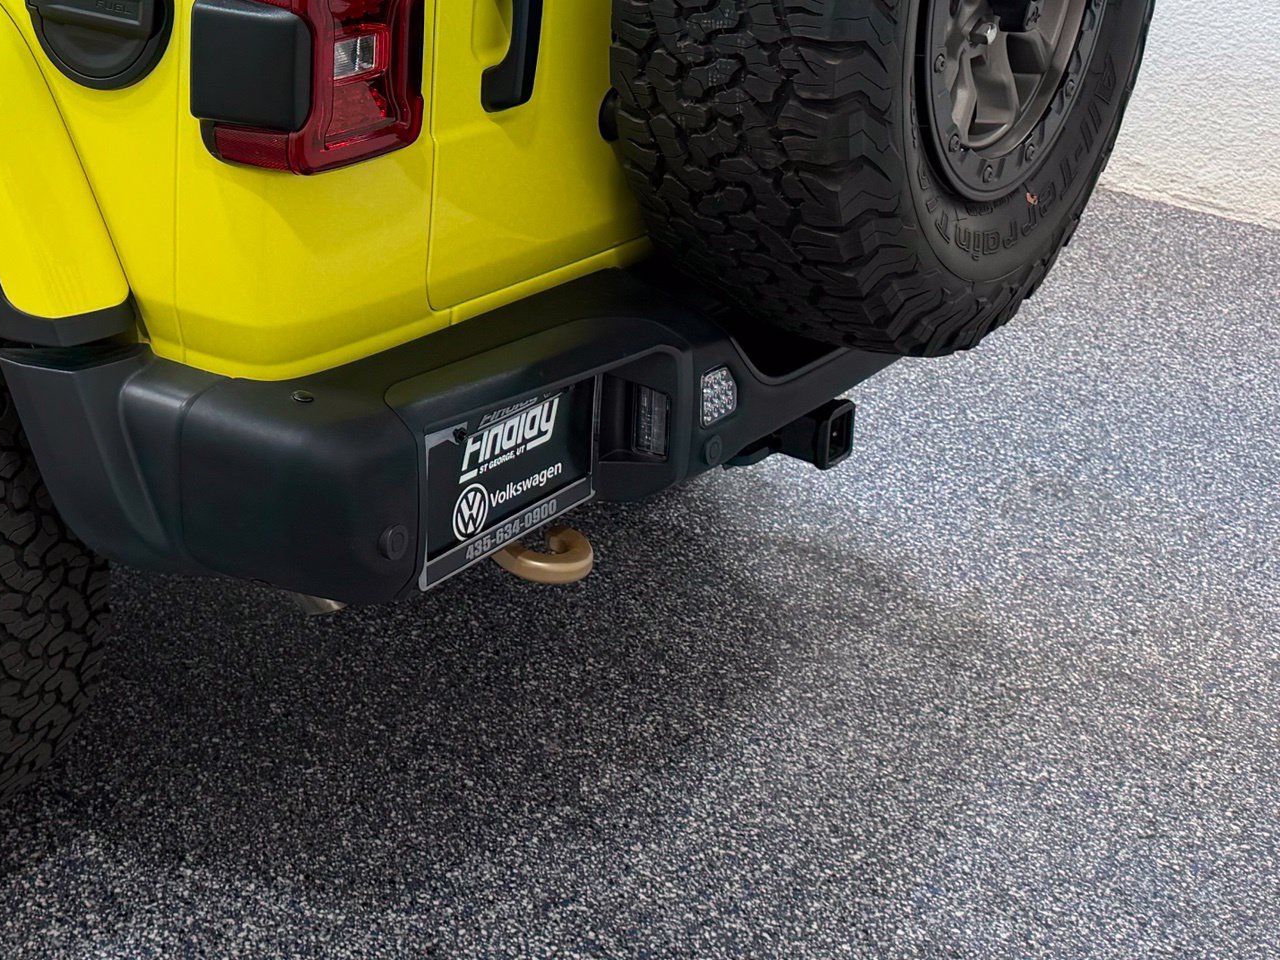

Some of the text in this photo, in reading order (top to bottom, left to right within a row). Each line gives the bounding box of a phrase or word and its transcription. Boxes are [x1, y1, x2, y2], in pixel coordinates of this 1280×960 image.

[95, 0, 132, 15] FUEL
[461, 397, 560, 472] Findlay
[479, 445, 526, 474] ST GEORGE, UT
[490, 462, 562, 507] Volkswagen
[465, 499, 557, 560] 435-634-0900
